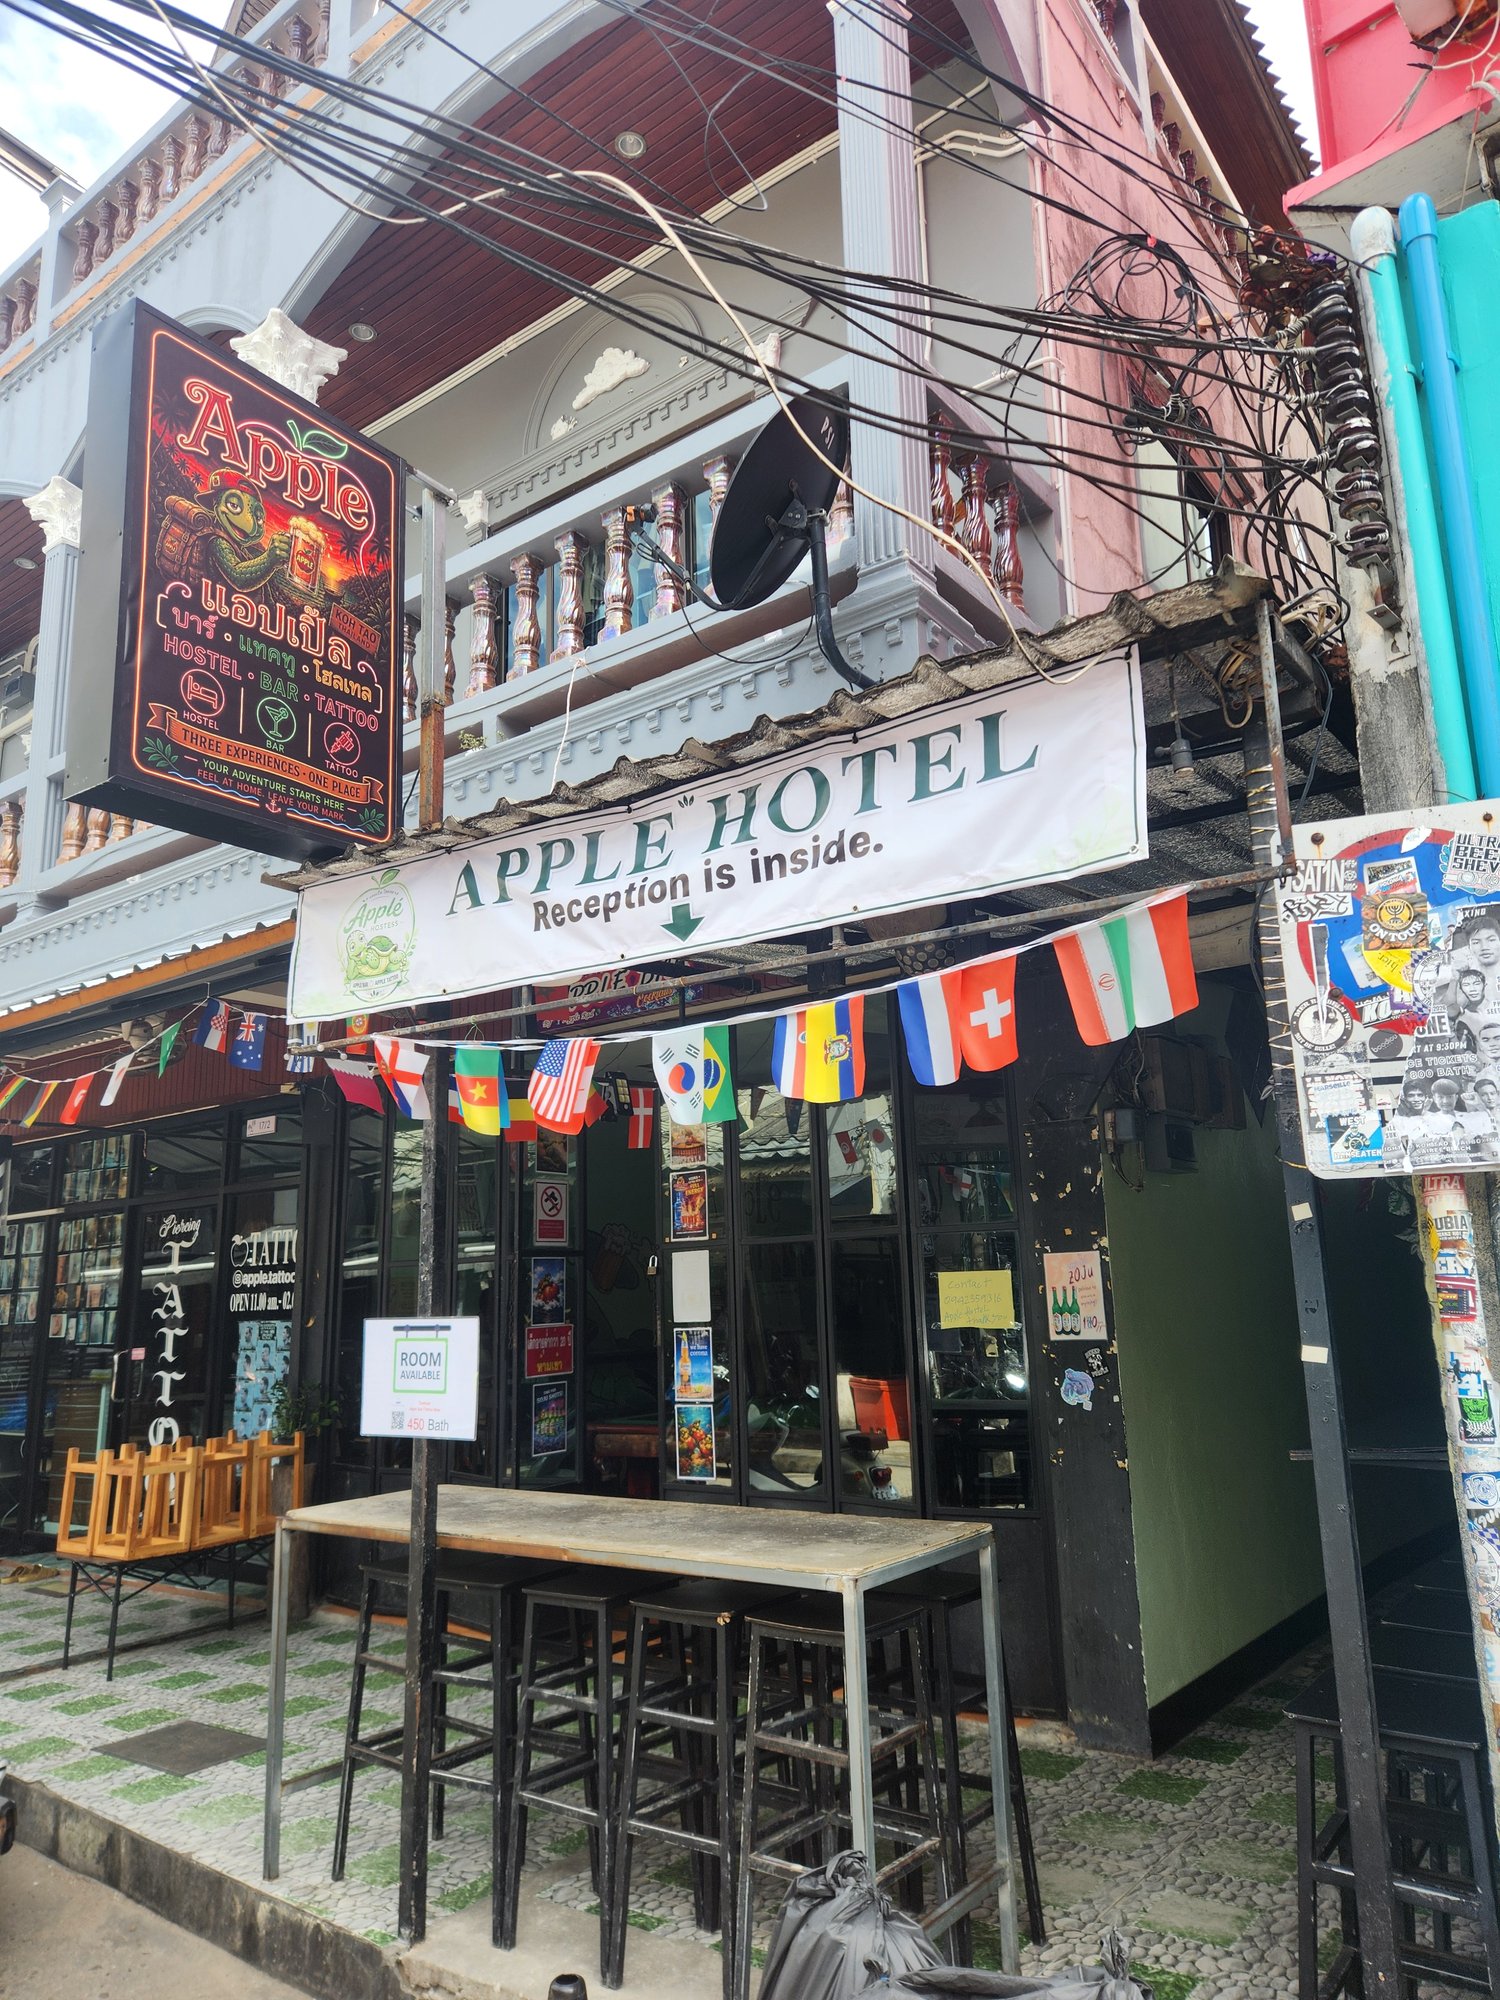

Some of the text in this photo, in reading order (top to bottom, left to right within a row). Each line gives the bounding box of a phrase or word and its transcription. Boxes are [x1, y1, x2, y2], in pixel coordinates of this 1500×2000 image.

[177, 379, 369, 530] Apple
[334, 609, 377, 644] KOH TAO
[337, 624, 371, 649] THAILAND
[164, 634, 378, 732] HOSTEL BAR TATTOO
[183, 710, 219, 730] HOSTEL
[266, 740, 285, 753] BAR
[182, 728, 361, 798] THREE EXPERIENCES ONE PLACE
[325, 759, 358, 778] TATTOO
[203, 758, 345, 811] YOUR ADVENTURE STARTS HERE
[197, 769, 346, 822] FEEL AT HOME. LEAVE YOUR MARK.
[446, 708, 1040, 918] APPLE HOTEL
[1457, 834, 1500, 849] ULTR
[532, 832, 885, 933] Reception is inside.
[1369, 921, 1424, 942] ON TOUR
[1424, 1043, 1434, 1053] AT
[1436, 1041, 1467, 1052] 9:30PM
[1426, 1053, 1478, 1067] TICKETS
[1437, 1065, 1472, 1077] BATH
[1339, 1116, 1366, 1126] WEST
[159, 1214, 201, 1242] Piercing
[230, 1293, 250, 1312] OPEN
[250, 1292, 267, 1311] 11.00
[400, 1352, 441, 1367] ROOM
[400, 1371, 440, 1380] AVAILABLE
[407, 1418, 449, 1431] 450 Bath
